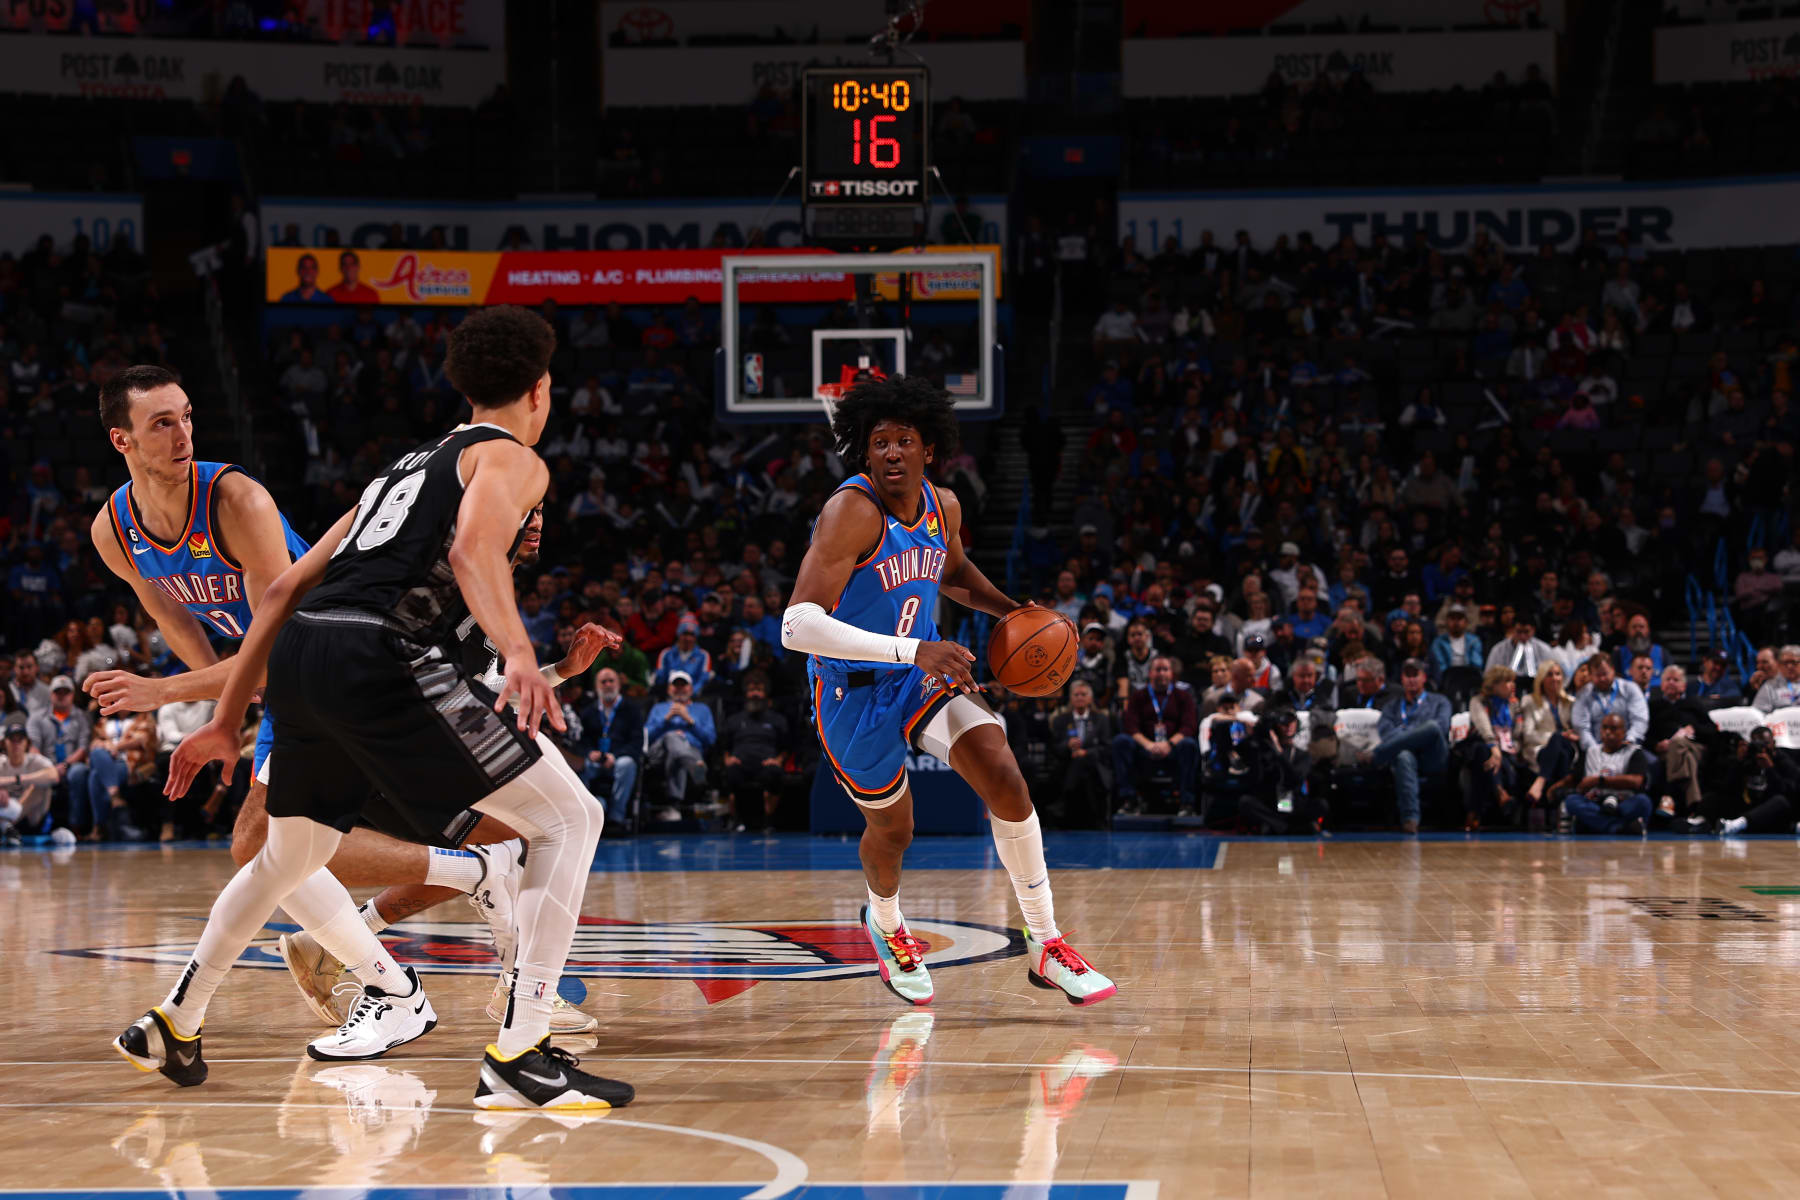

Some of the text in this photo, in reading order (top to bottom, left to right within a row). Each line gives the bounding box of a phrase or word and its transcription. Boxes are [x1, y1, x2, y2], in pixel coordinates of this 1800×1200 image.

[1731, 38, 1781, 64] POST
[61, 53, 184, 80] POST OAK
[324, 63, 442, 89] POST OAK
[752, 62, 800, 87] POST
[1274, 54, 1322, 78] POST
[832, 80, 911, 112] 10:40
[852, 114, 901, 168] 16
[840, 180, 919, 196] TISSOT
[1325, 207, 1674, 249] THUNDER
[507, 270, 582, 286] HEATING
[592, 270, 625, 285] A/C
[635, 269, 722, 284] PLUMBING
[330, 469, 426, 560] 18
[129, 528, 139, 543] 6
[873, 546, 946, 592] THUNDER
[896, 595, 921, 638] 8
